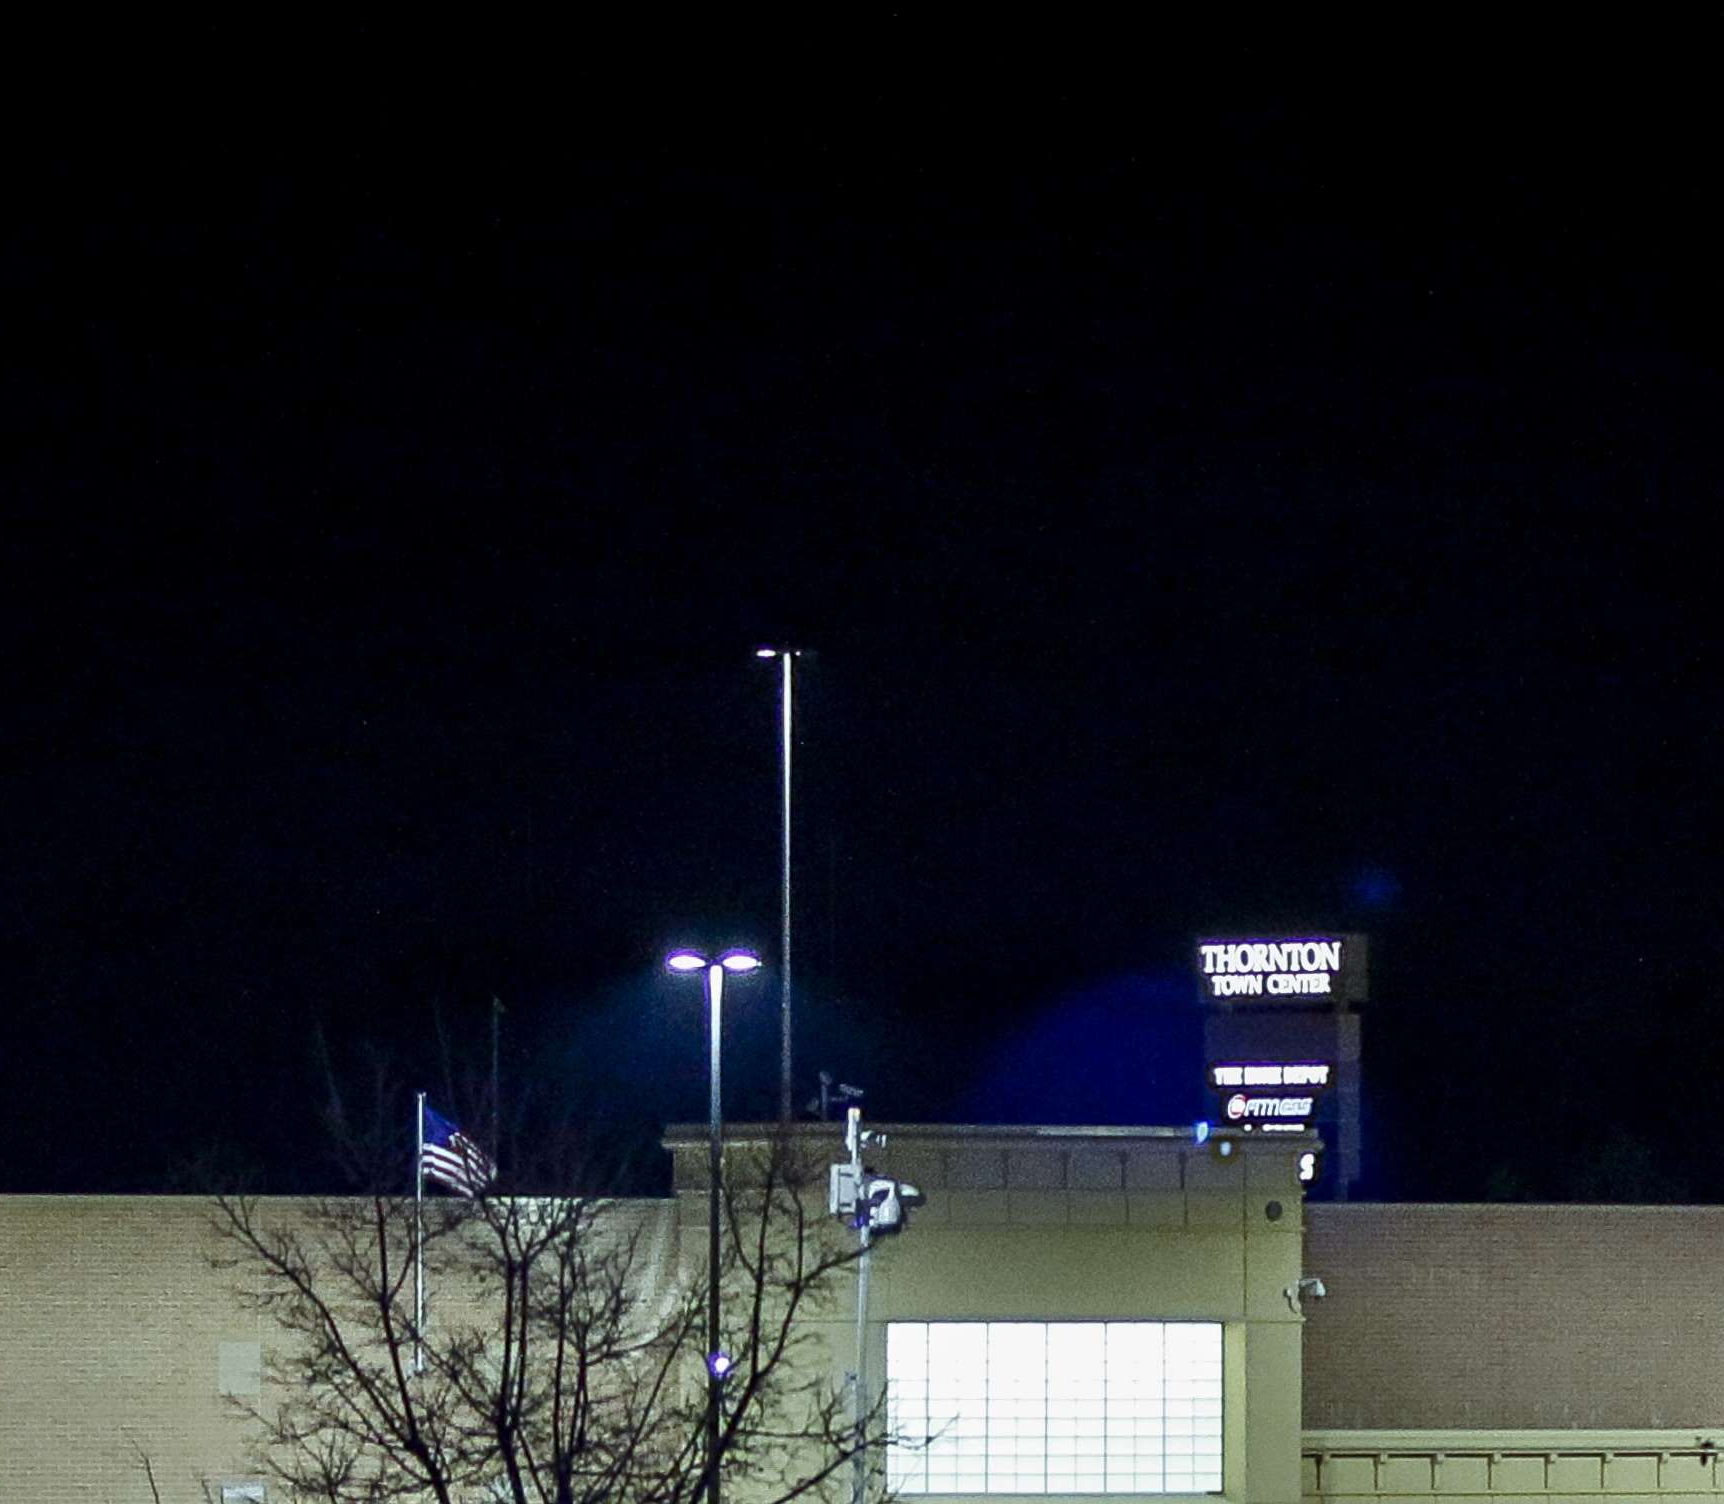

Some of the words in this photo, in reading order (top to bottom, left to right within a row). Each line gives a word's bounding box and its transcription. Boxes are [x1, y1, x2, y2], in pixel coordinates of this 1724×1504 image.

[1200, 942, 1342, 974] THORNTON
[1212, 974, 1263, 996] TOWN
[1266, 973, 1331, 995] CENTER
